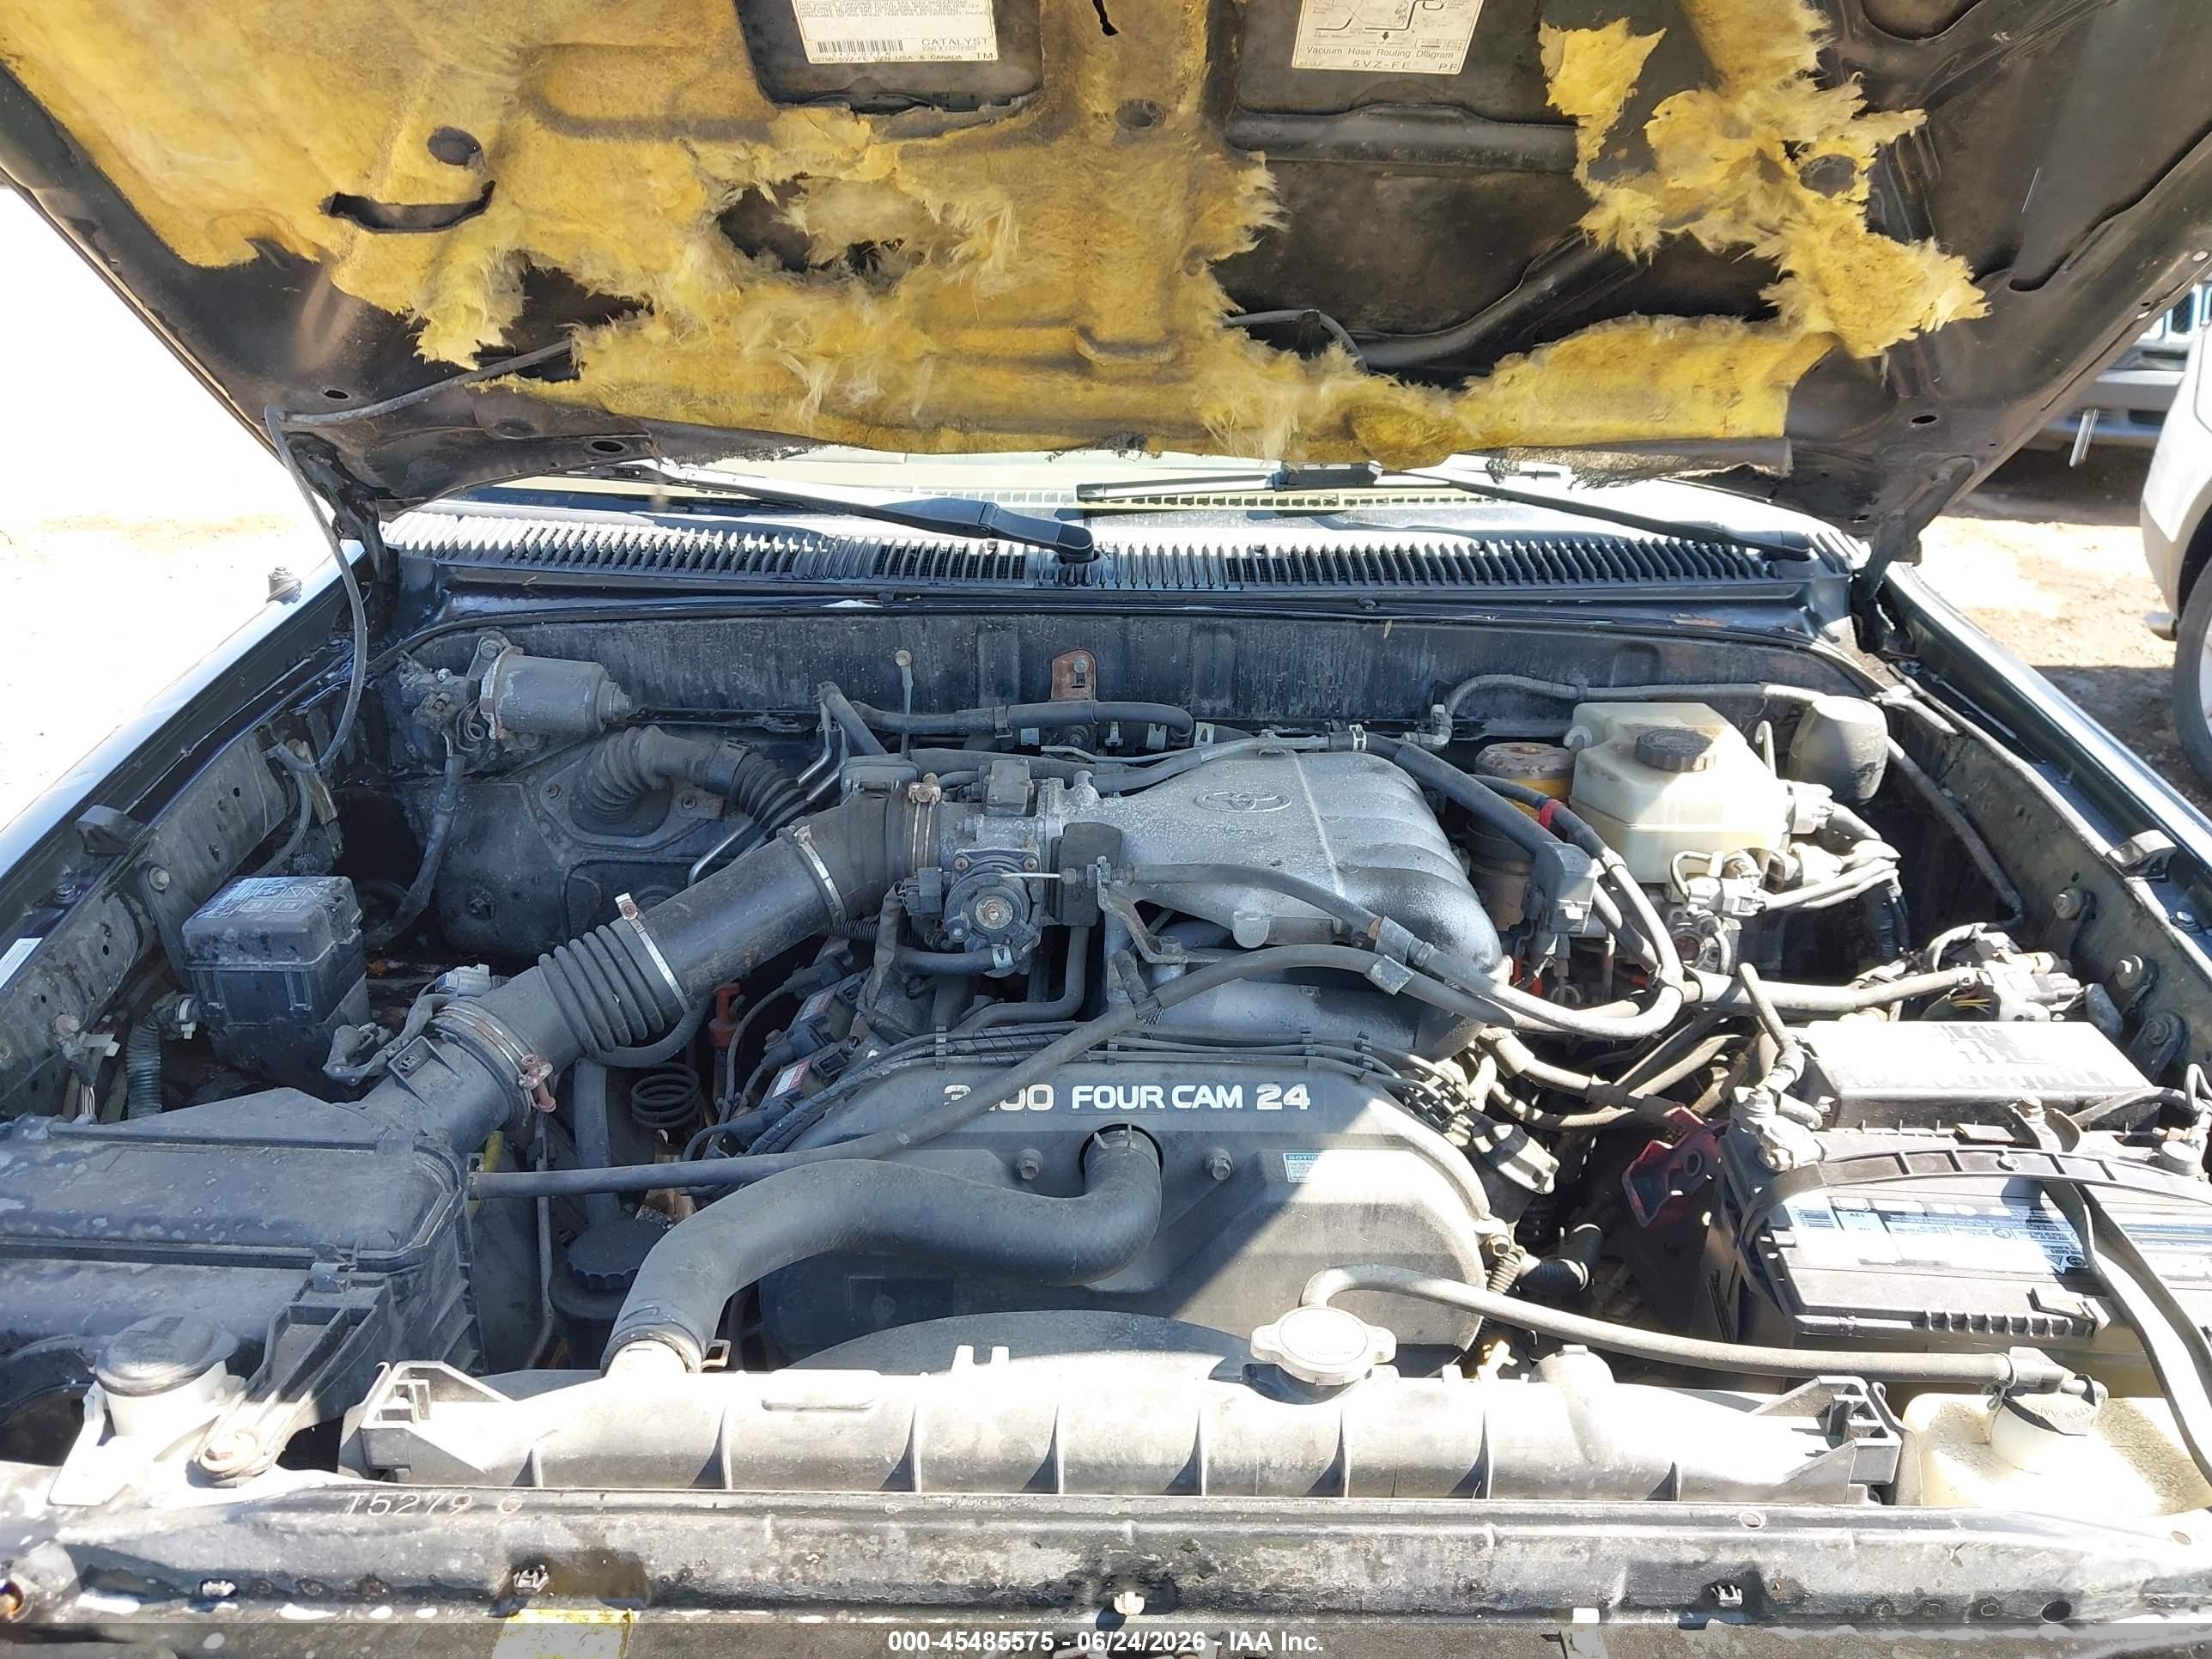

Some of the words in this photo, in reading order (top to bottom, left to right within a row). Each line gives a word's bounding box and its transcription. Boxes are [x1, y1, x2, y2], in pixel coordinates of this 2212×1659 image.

[1307, 46, 1342, 56] Vacuum
[1348, 47, 1371, 56] Hose
[1376, 48, 1411, 58] Routing
[1416, 50, 1454, 59] Diagram
[1439, 63, 1458, 71] PF
[1072, 1085, 1166, 1109] FOUR
[1171, 1085, 1243, 1109] CAM
[1256, 1083, 1311, 1110] 24
